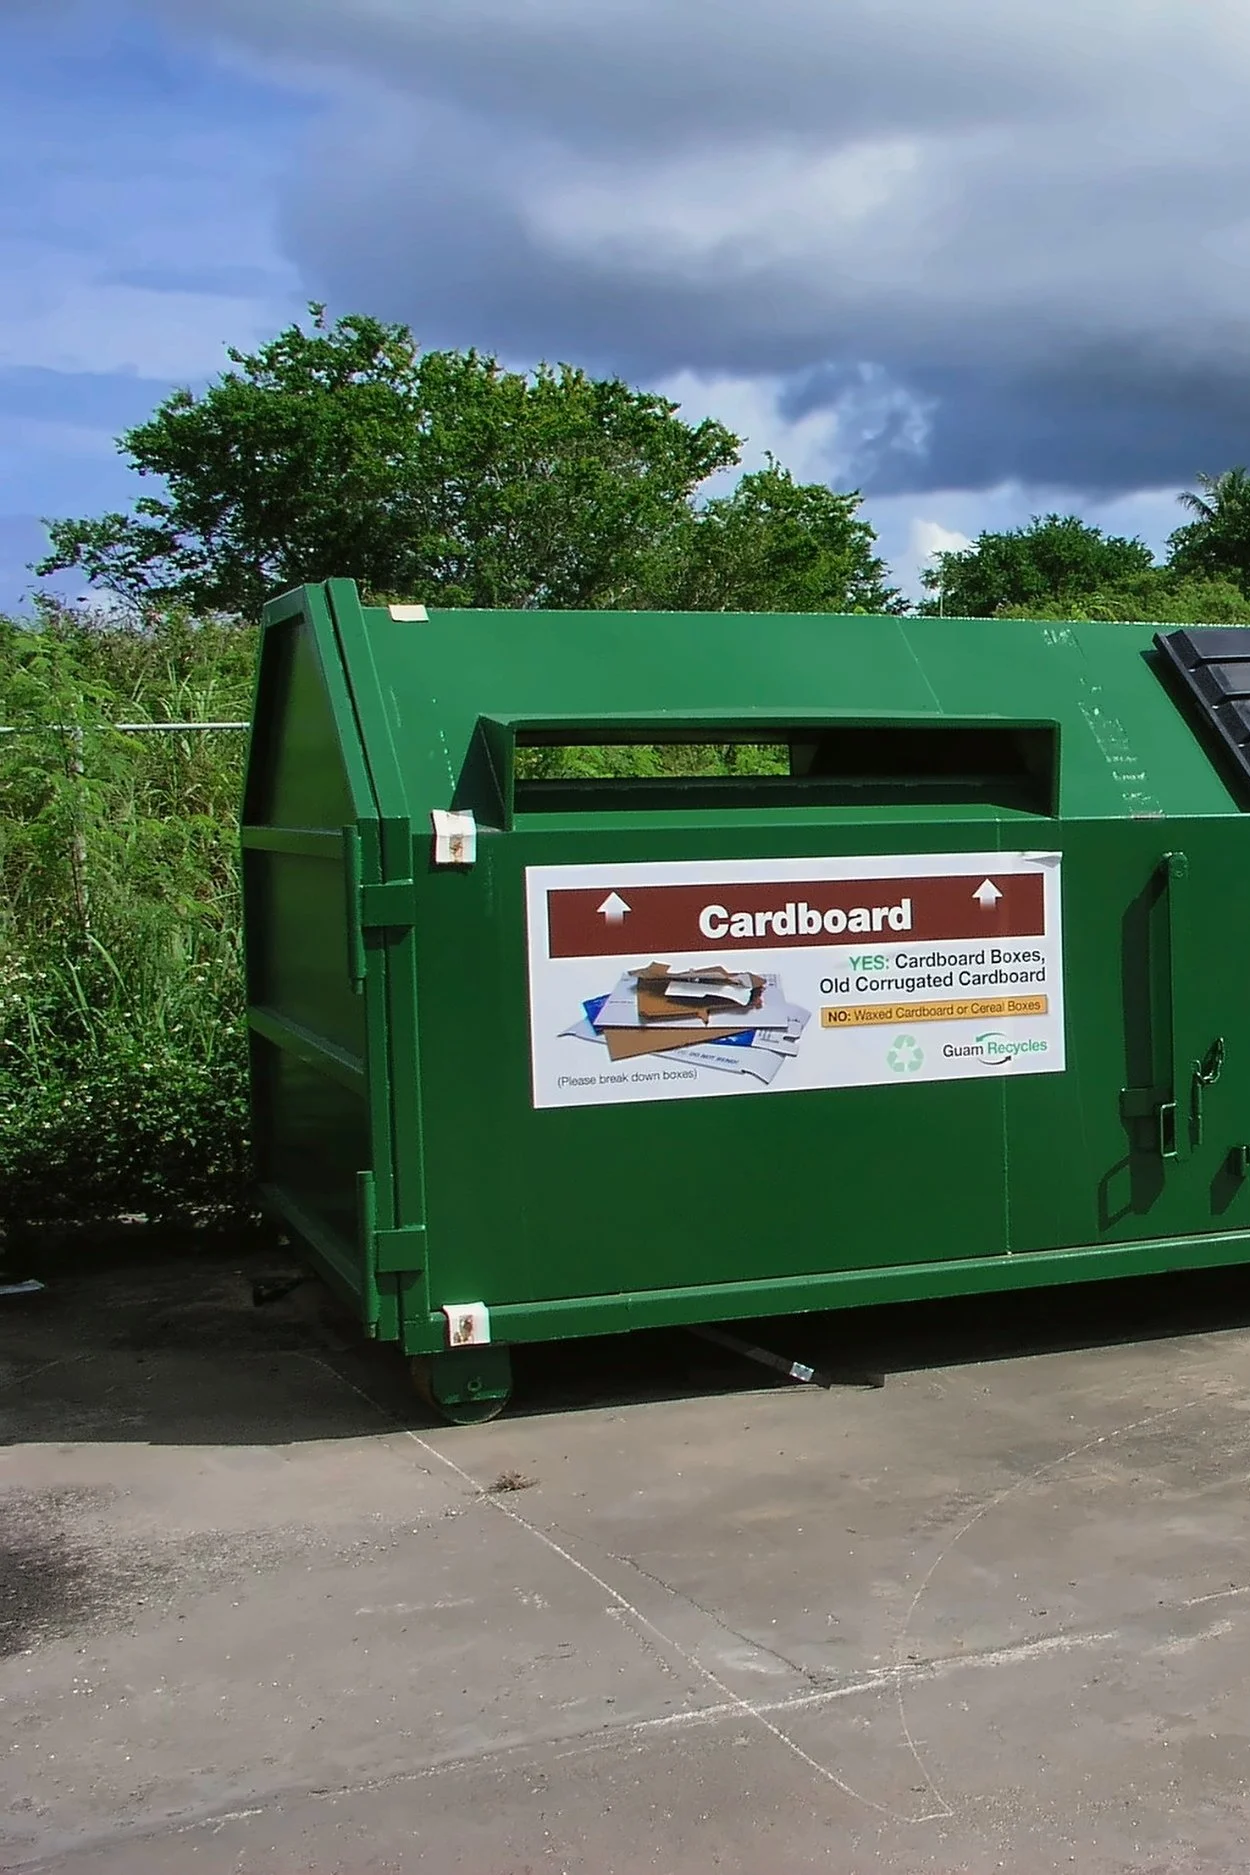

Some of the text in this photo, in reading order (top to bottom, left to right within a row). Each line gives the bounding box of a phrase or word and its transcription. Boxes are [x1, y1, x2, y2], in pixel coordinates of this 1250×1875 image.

[698, 898, 912, 939] Cardboard
[849, 949, 1045, 971] YES: Cardboard Boxes,
[820, 967, 1046, 994] Old Corrugated Cardboard
[828, 999, 1041, 1023] NO: Waxed Cardboard or Cereal Boxes
[943, 1038, 1047, 1058] Guam Recycles
[557, 1068, 698, 1089] (Please break down boxes)
